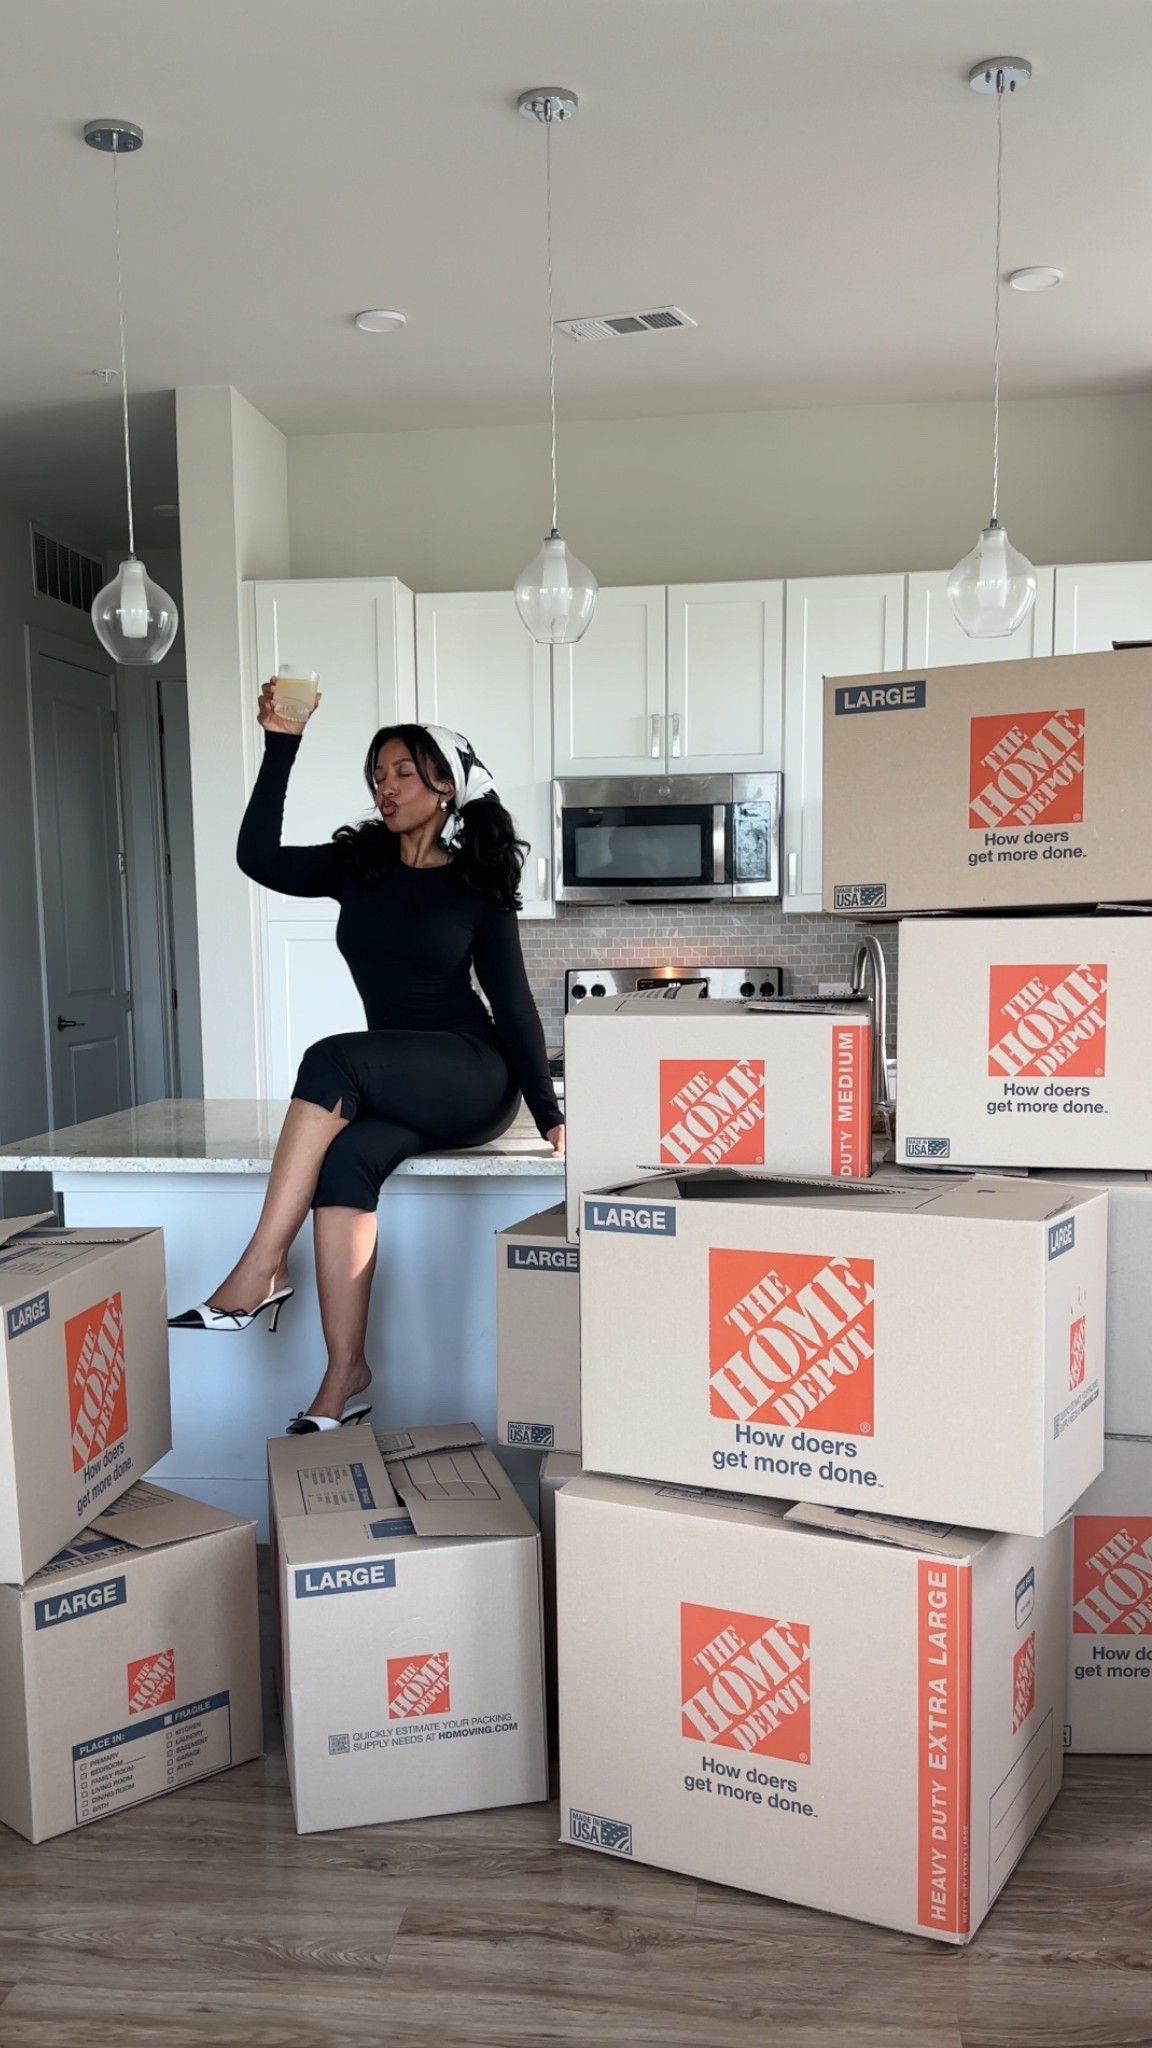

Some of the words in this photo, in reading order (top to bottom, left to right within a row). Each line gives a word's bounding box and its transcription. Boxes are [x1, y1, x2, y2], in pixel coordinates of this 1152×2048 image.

[844, 686, 916, 710] LARGE
[980, 725, 1029, 773] THE
[968, 709, 1085, 828] HOME
[1013, 751, 1084, 826] DEPOT
[984, 831, 1019, 847] How
[1023, 830, 1069, 845] doers
[968, 850, 994, 866] get
[998, 850, 1038, 863] more
[836, 893, 859, 907] USA
[1000, 976, 1050, 1021] THE
[988, 963, 1108, 1077] HOME
[1033, 1005, 1106, 1077] DEPOT
[669, 1070, 715, 1112] THE
[838, 1032, 854, 1122] MEDIUM
[1003, 1083, 1040, 1096] How
[1044, 1083, 1090, 1097] doers
[660, 1060, 765, 1164] HOME
[986, 1101, 1013, 1115] get
[1017, 1102, 1058, 1113] more
[702, 1098, 765, 1164] DEPOT
[840, 1130, 853, 1176] DUTY
[908, 1144, 927, 1156] USA
[593, 1206, 666, 1230] LARGE
[1050, 1223, 1072, 1254] LARGE
[514, 1249, 578, 1268] LARGE
[11, 1298, 46, 1332] LARGE
[723, 1270, 793, 1337] THE
[74, 1324, 96, 1387] THE
[709, 1256, 875, 1422] HOME
[71, 1297, 122, 1463] HOME
[771, 1323, 874, 1428] DEPOT
[95, 1346, 125, 1450] DEPOT
[510, 1429, 530, 1442] USA
[735, 1424, 785, 1448] How
[791, 1432, 857, 1457] doers
[84, 1462, 101, 1484] How
[103, 1442, 125, 1467] doers
[712, 1448, 747, 1469] get
[754, 1456, 812, 1477] more
[77, 1493, 90, 1516] get
[92, 1476, 112, 1496] more
[1085, 1528, 1138, 1576] THE
[304, 1565, 385, 1592] LARGE
[1073, 1536, 1152, 1634] HOM
[44, 1583, 117, 1622] LARGE
[928, 1571, 948, 1666] LARGE
[692, 1624, 746, 1676] THE
[1092, 1646, 1130, 1660] How
[129, 1651, 174, 1711] HOME
[133, 1662, 152, 1686] THE
[148, 1668, 175, 1707] DEPOT
[389, 1653, 449, 1718] HOME
[394, 1662, 420, 1689] THE
[681, 1619, 811, 1743] HOME
[1074, 1665, 1102, 1680] get
[1107, 1666, 1150, 1678] more
[174, 1701, 211, 1721] FRAGILE
[413, 1675, 449, 1715] DEPOT
[175, 1722, 202, 1736] KITCHEN
[353, 1729, 394, 1741] QUICKLY
[396, 1723, 440, 1735] ESTIMATE
[441, 1719, 469, 1730] YOUR
[471, 1713, 512, 1726] PACKING
[730, 1675, 810, 1752] DEPOT
[928, 1678, 948, 1771] EXTRA
[79, 1739, 110, 1755] PLACE
[112, 1733, 125, 1744] IN:
[175, 1730, 204, 1744] LAUNDRY
[176, 1737, 208, 1754] BASEMENT
[353, 1740, 390, 1752] SUPPLY
[391, 1735, 423, 1746] NEEDS
[425, 1733, 437, 1742] AT
[438, 1723, 518, 1740] HDMOVING.COM
[90, 1752, 119, 1767] PRIMARY
[90, 1760, 124, 1777] BEDROOM
[176, 1749, 201, 1762] GARAGE
[177, 1760, 193, 1771] ATTIC
[91, 1773, 114, 1786] FAMILY
[115, 1765, 134, 1778] ROOM
[91, 1782, 113, 1795] LIVING
[113, 1775, 133, 1786] ROOM
[684, 1775, 712, 1793] get
[717, 1783, 763, 1804] more
[702, 1756, 741, 1779] How
[746, 1768, 798, 1792] doers
[92, 1791, 115, 1804] DINING
[115, 1783, 135, 1795] ROOM
[92, 1802, 109, 1813] BATH
[573, 1812, 591, 1825] MADE
[593, 1817, 600, 1826] IN
[931, 1780, 948, 1841] DUTY
[573, 1820, 600, 1844] USA
[931, 1848, 947, 1921] HEAVY
